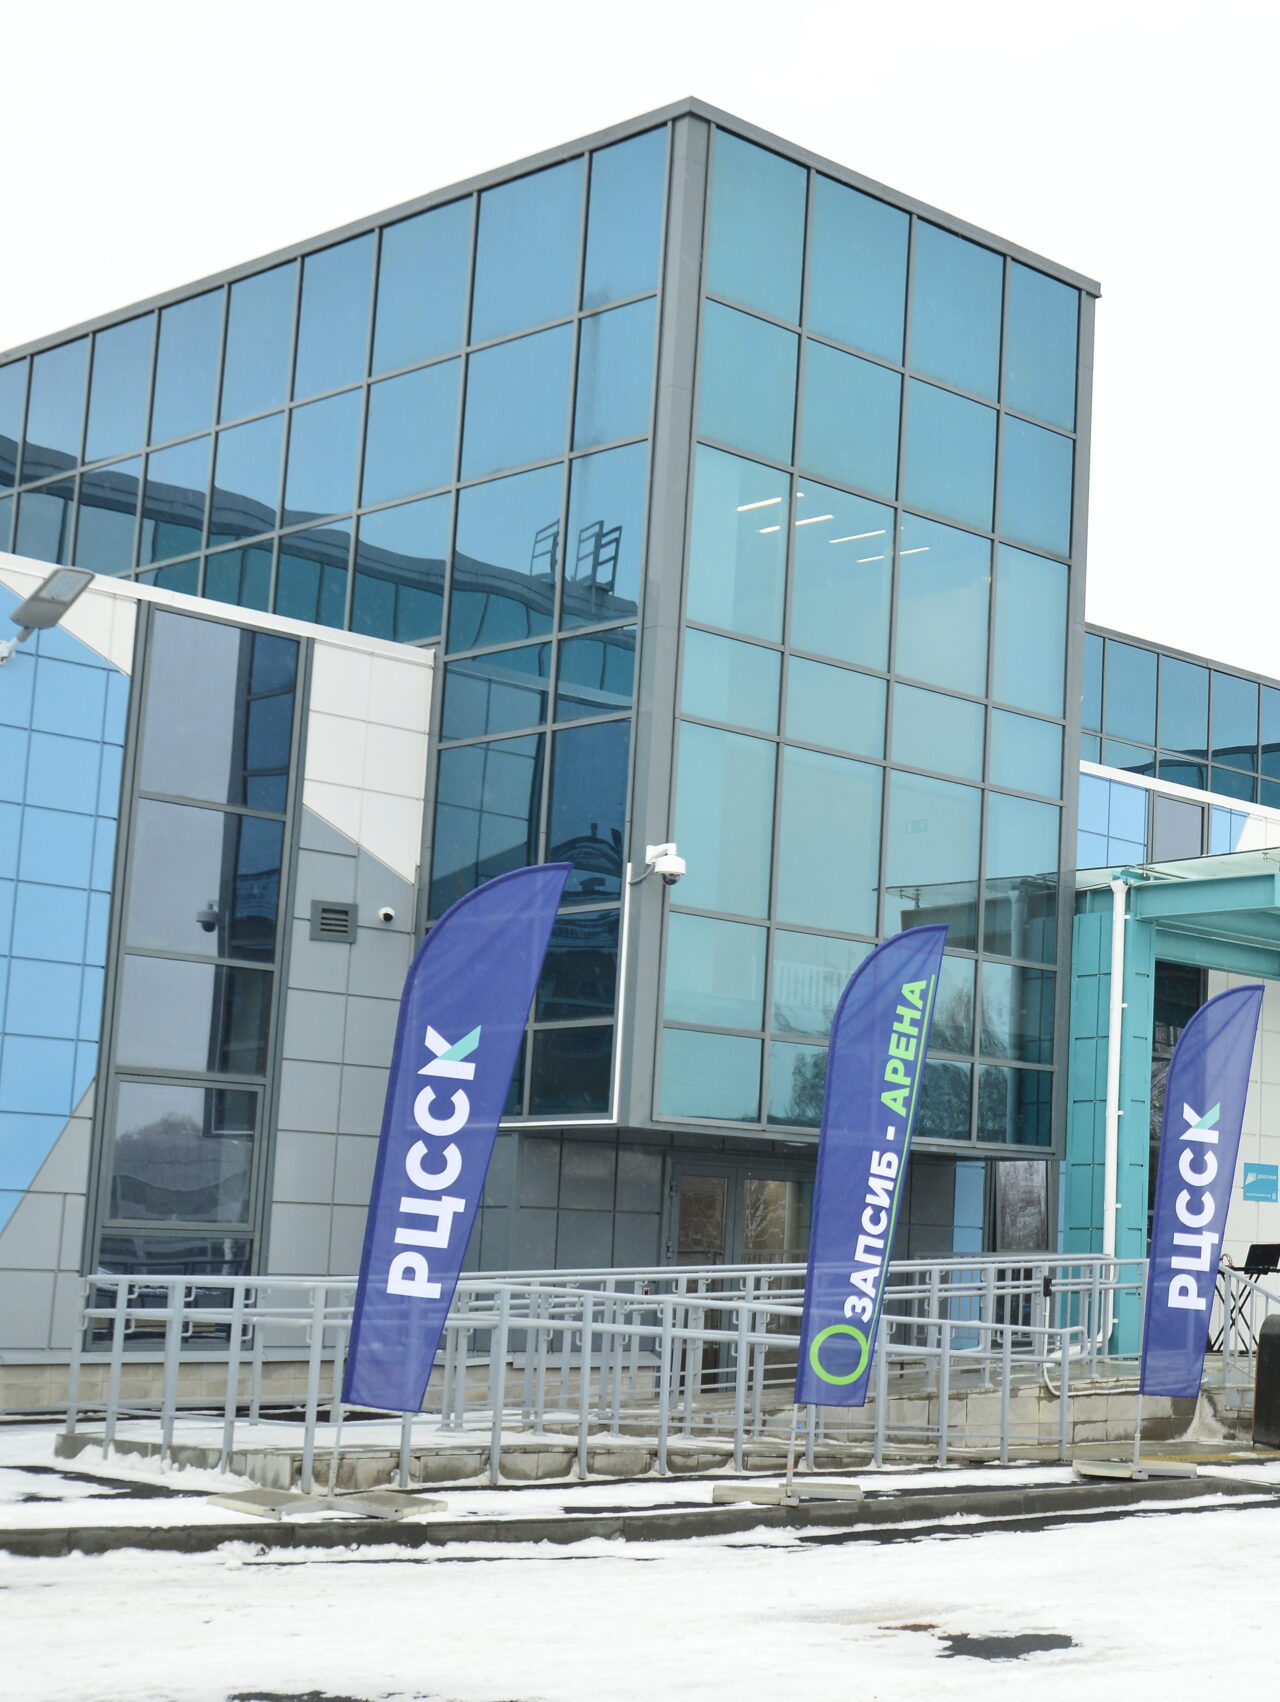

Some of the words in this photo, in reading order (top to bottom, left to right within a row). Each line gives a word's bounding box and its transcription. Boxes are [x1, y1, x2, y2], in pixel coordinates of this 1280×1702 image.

[386, 1025, 481, 1299] РЦССК
[843, 1150, 899, 1323] ЗАПСИБ
[881, 980, 927, 1118] АРЕНА
[1168, 1102, 1221, 1310] РЦССК
